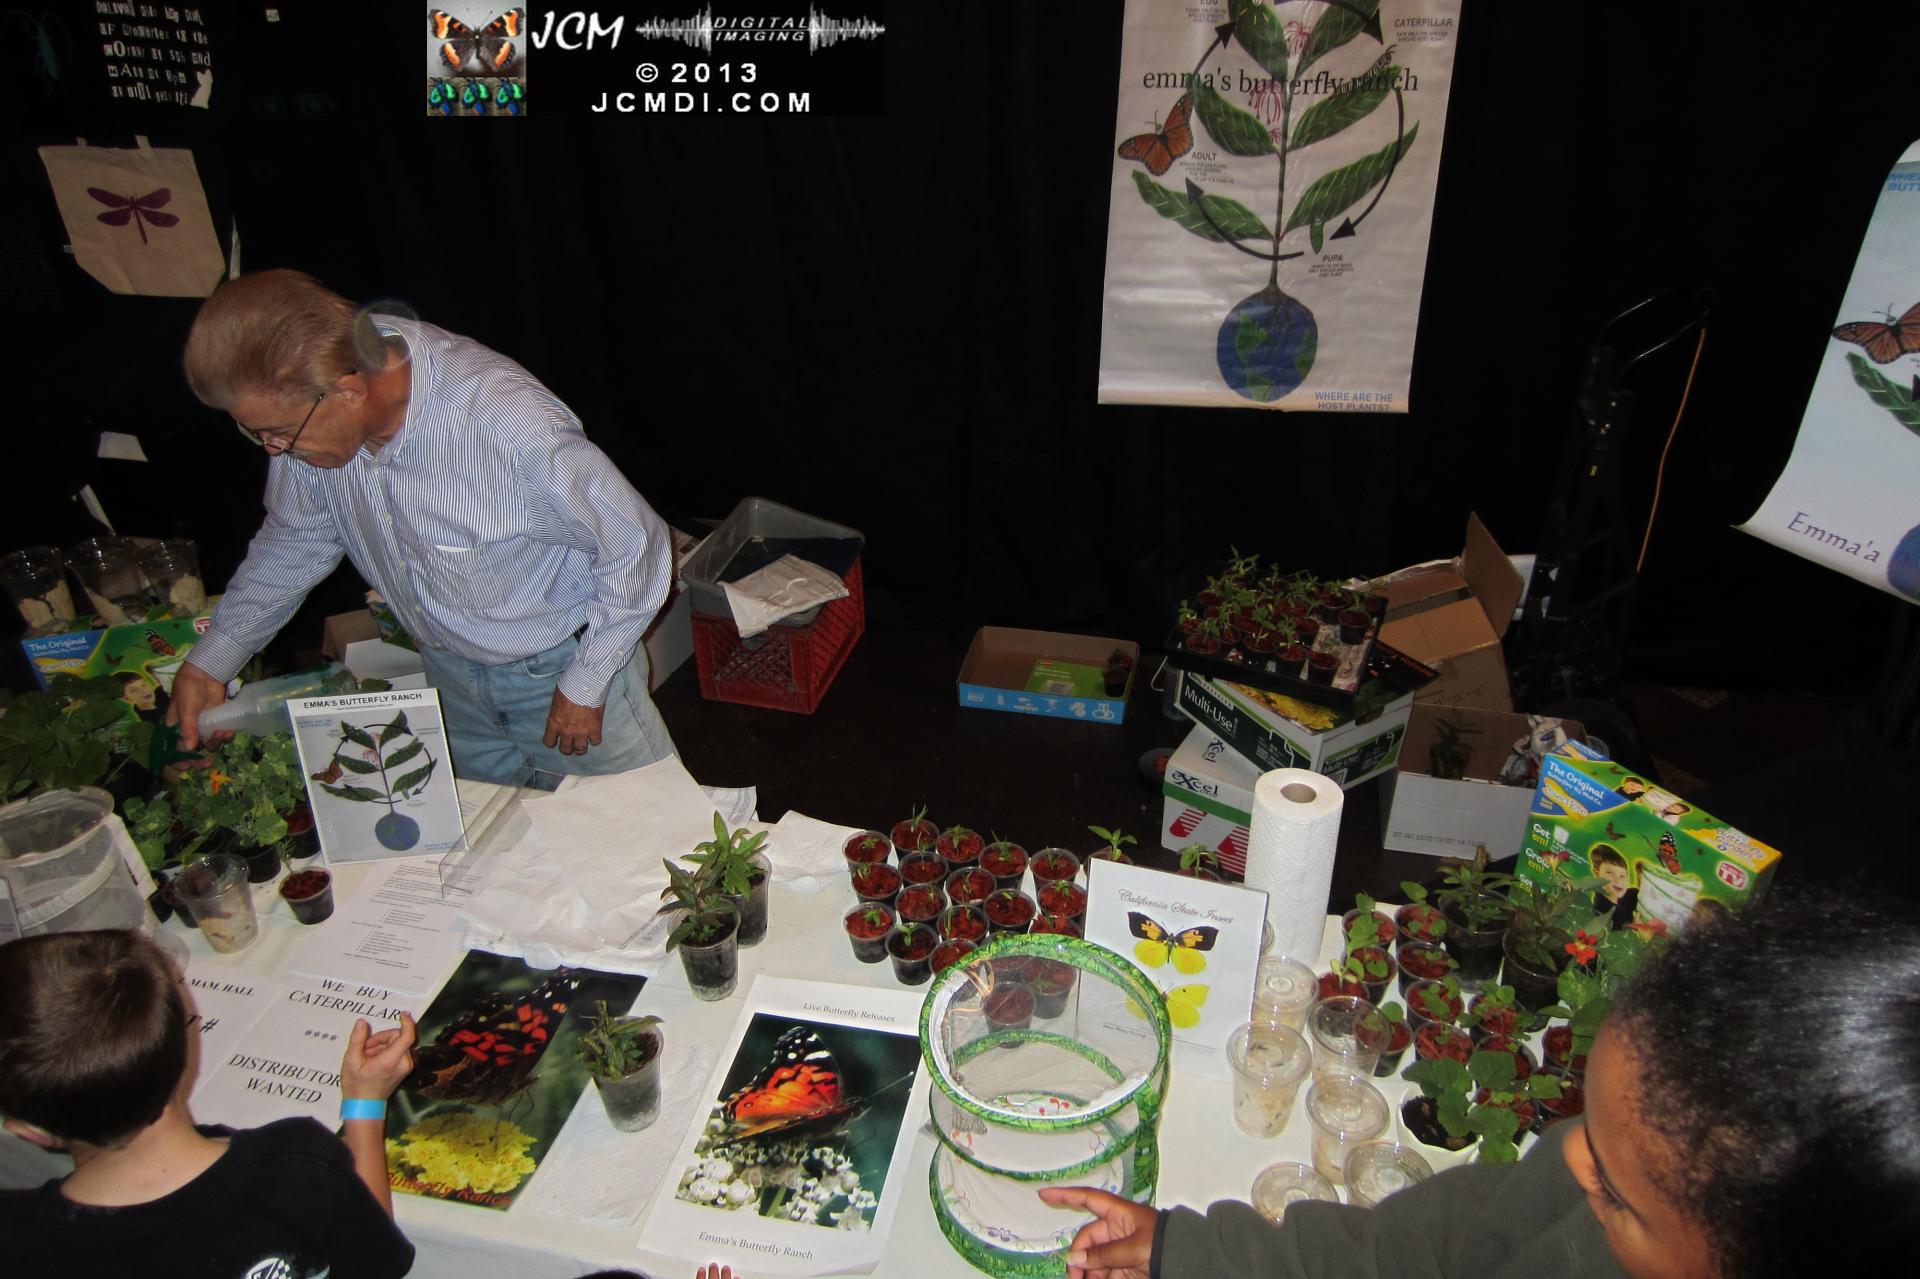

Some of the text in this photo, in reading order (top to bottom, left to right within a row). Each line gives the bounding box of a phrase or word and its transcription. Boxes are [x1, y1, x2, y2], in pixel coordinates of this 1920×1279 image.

[1394, 18, 1453, 28] CATERPILLAR
[1142, 67, 1419, 97] emma's butterfly ranch
[1192, 152, 1217, 161] ADULT
[1322, 254, 1343, 262] PUPA
[1315, 391, 1393, 403] WHERE ARE THE
[1318, 401, 1389, 412] HOST PLANTS?
[1786, 511, 1881, 564] Emma'a
[29, 643, 48, 652] The
[48, 636, 87, 649] Original
[303, 699, 338, 709] EMMA'S
[339, 695, 389, 706] BUTTERFLY
[391, 692, 423, 702] RANCH
[1184, 684, 1234, 733] Multi-Use
[1548, 760, 1606, 800] The Original
[1533, 823, 1551, 839] Get
[1118, 888, 1234, 924] California State Insect
[222, 984, 254, 997] HALL
[321, 979, 394, 1001] WE BUY
[803, 1002, 896, 1022] Live Butterfly Releases
[247, 1077, 322, 1104] WANTED
[698, 1231, 813, 1260] Emma's Butterfly Ranch
